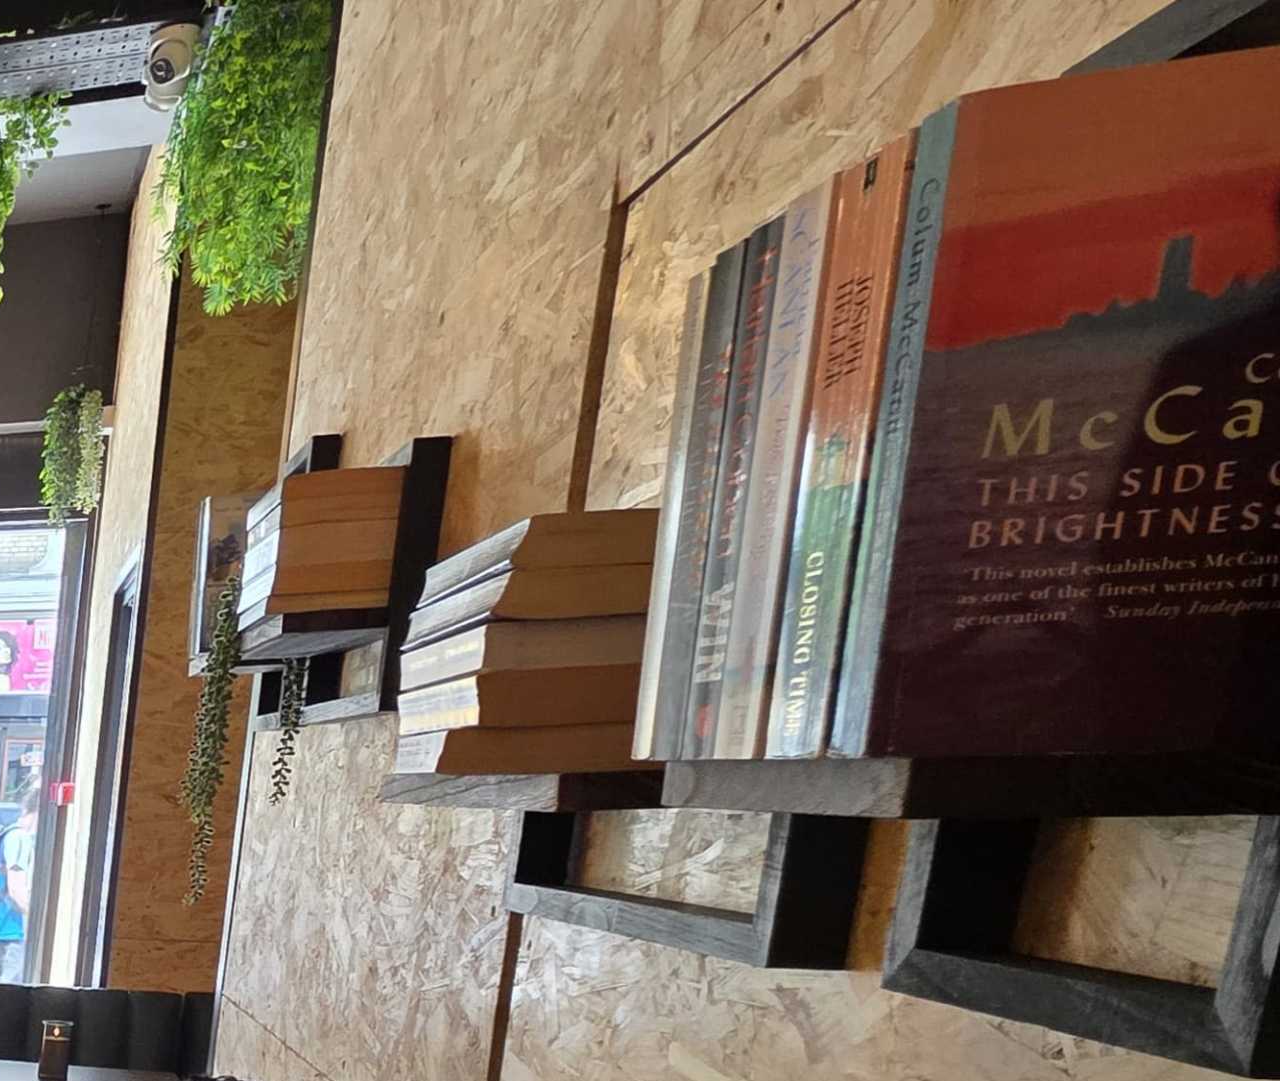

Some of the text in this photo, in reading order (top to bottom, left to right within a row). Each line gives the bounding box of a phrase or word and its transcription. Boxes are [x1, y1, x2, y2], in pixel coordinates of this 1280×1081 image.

[823, 278, 855, 390] HELLER
[849, 274, 874, 376] JOSEPH
[884, 177, 940, 436] Colum McCann
[1245, 352, 1280, 384] C
[978, 470, 1089, 507] THIS
[1120, 461, 1238, 496] SIDE
[957, 592, 978, 604] as
[983, 591, 1024, 603] one
[1029, 585, 1054, 601] of
[1057, 584, 1092, 600] the
[1097, 582, 1156, 597] finest
[1163, 577, 1235, 593] writers
[1019, 561, 1078, 578] novel
[1082, 556, 1197, 576] establishes
[694, 580, 734, 684] WIN
[783, 550, 825, 738] CLOSING TIME
[1104, 600, 1182, 621] Sunday
